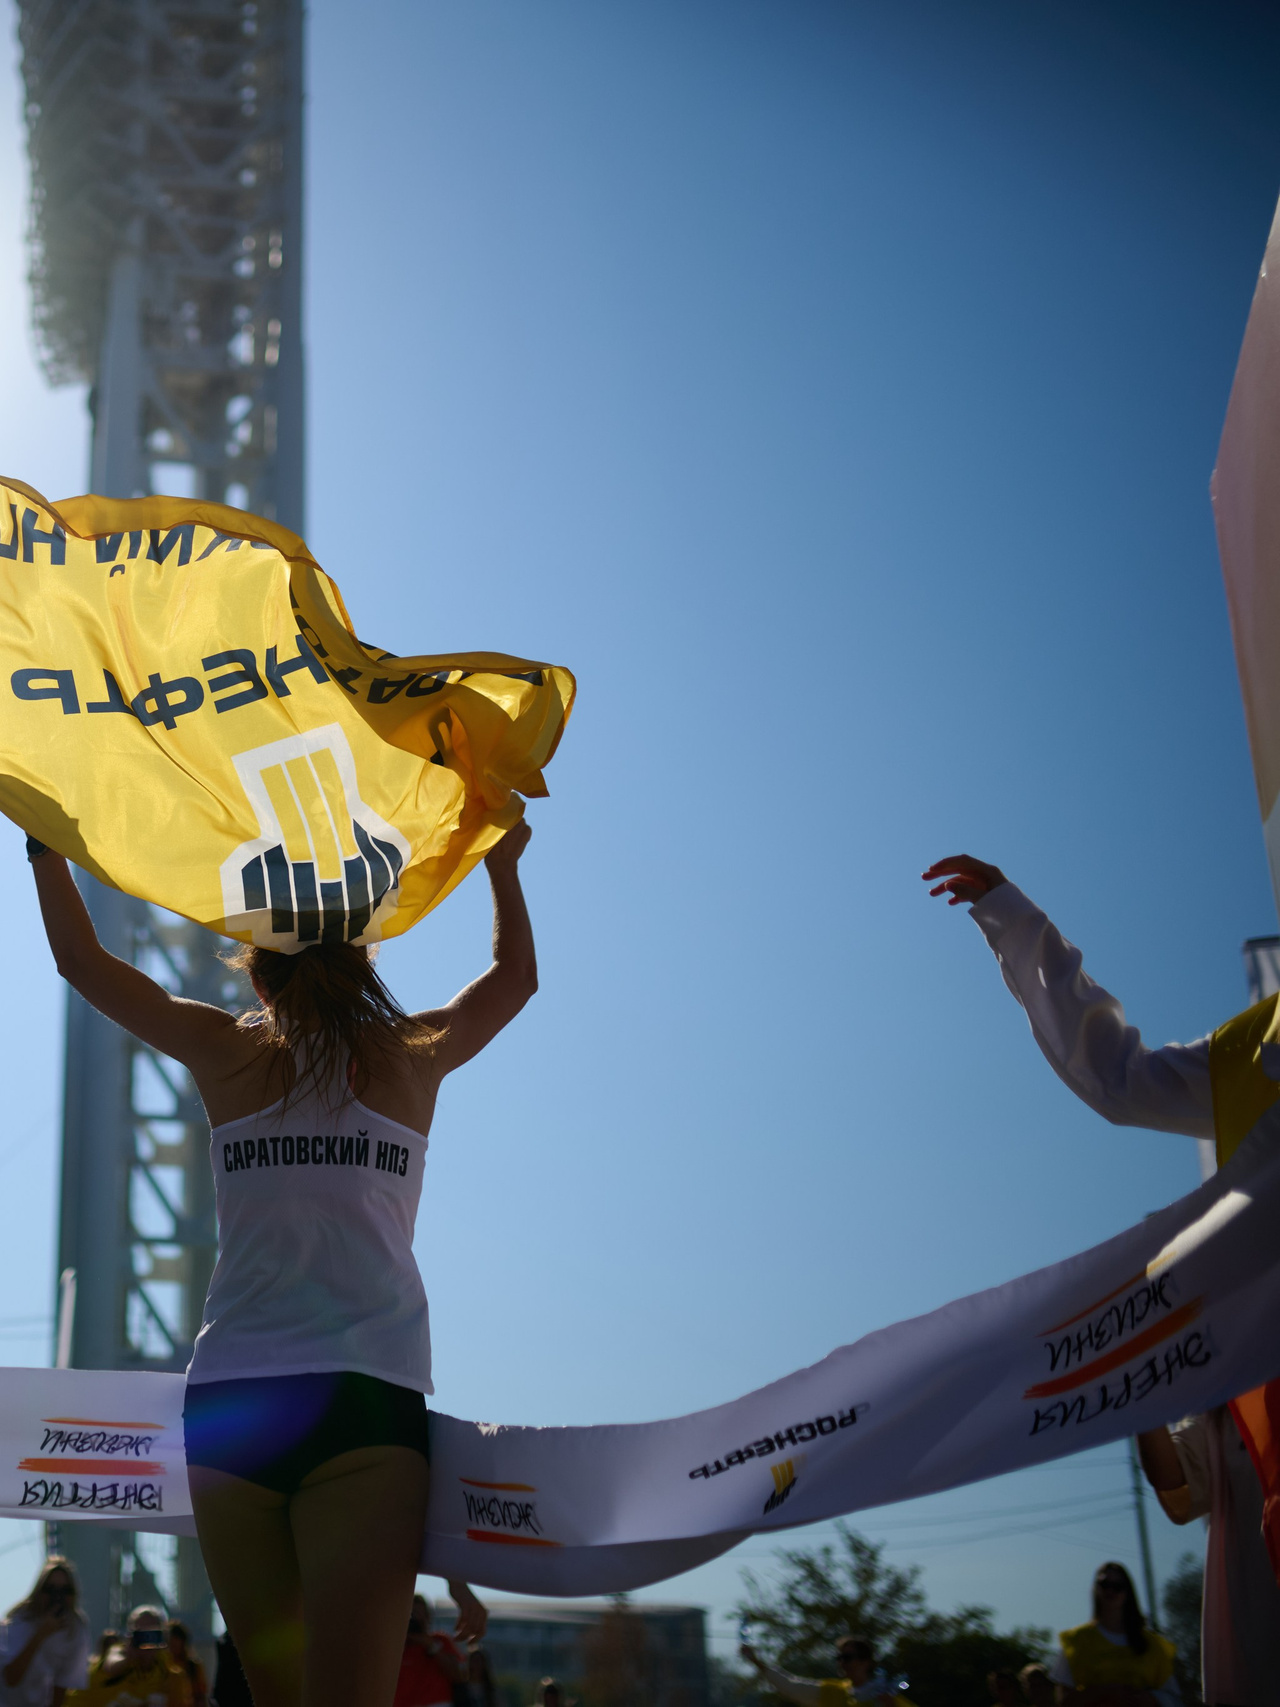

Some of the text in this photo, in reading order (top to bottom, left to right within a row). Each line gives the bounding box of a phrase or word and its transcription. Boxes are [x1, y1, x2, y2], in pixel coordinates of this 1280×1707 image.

[223, 1129, 409, 1177] САРАТОВСКИЙ НПЗ
[1045, 1271, 1173, 1371] ЖИЗНИ
[1029, 1331, 1212, 1435] ЭНЕРГИЯ
[688, 1406, 860, 1480] РОСНЕФТЬ
